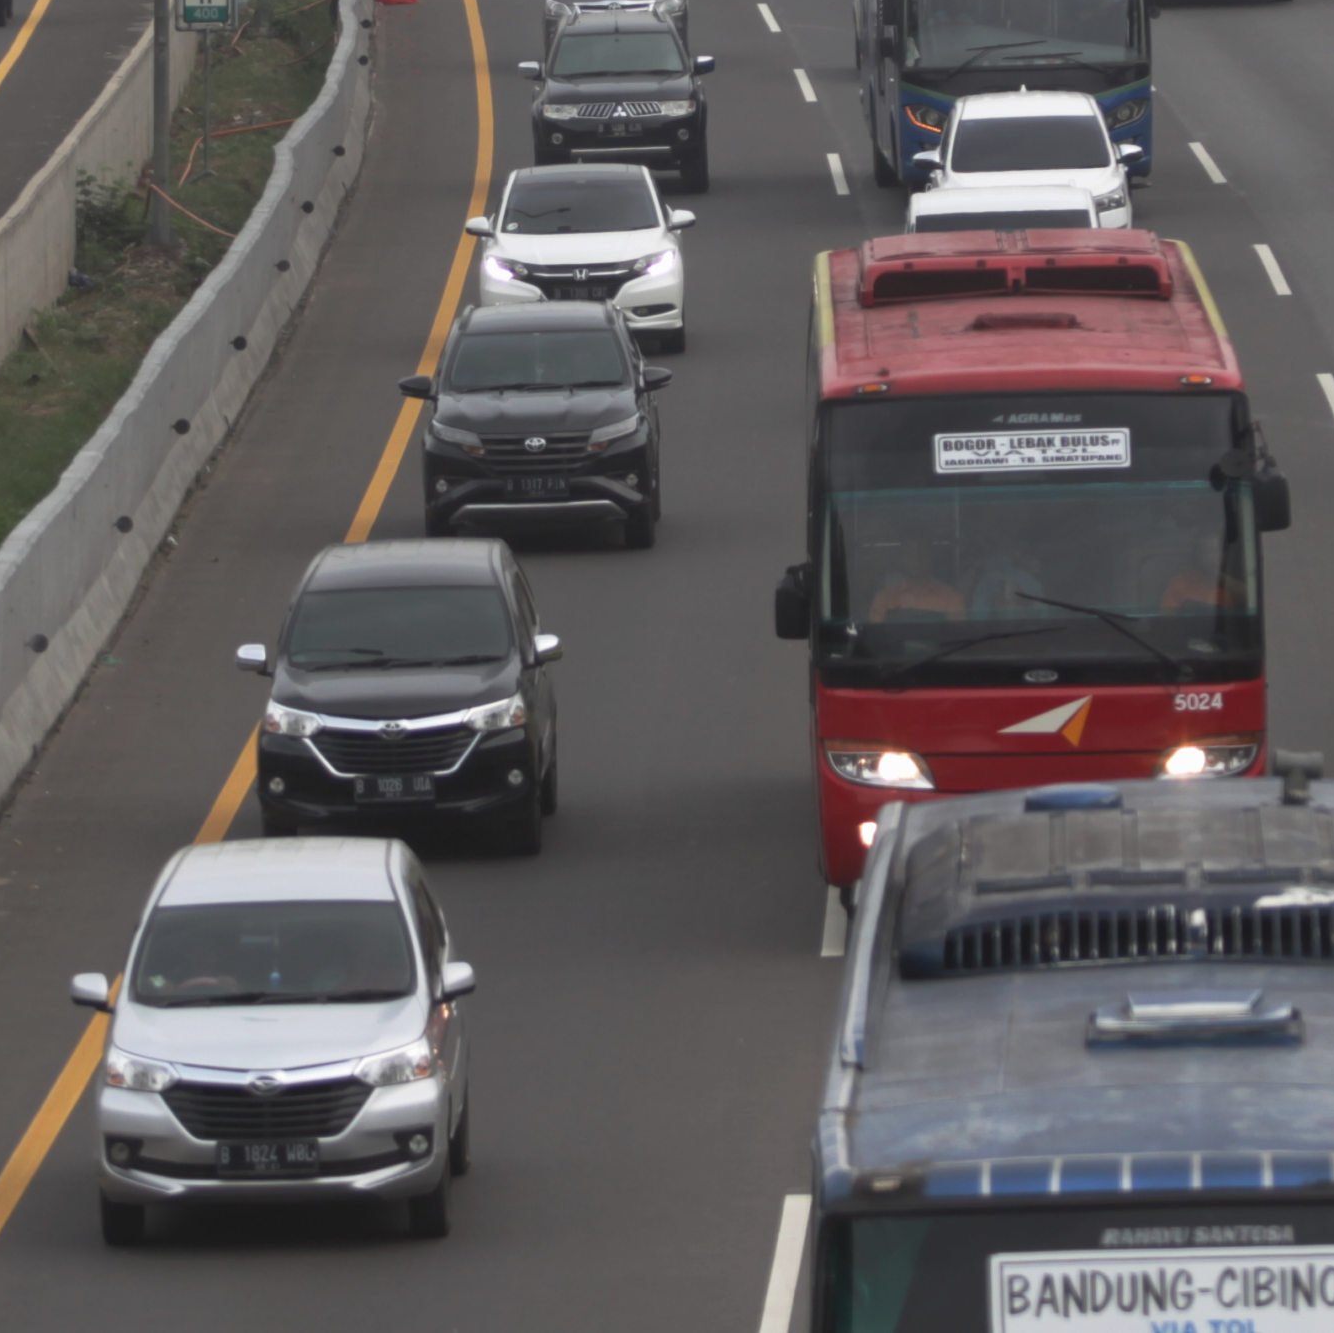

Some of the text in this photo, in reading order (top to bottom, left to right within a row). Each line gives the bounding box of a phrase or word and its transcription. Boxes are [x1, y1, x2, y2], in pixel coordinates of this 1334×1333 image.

[193, 8, 218, 19] 400
[943, 439, 996, 452] BOGOR
[1009, 436, 1056, 450] LEBAK
[1060, 434, 1110, 448] BULUS
[944, 457, 1008, 467] JAGORAWI
[1042, 453, 1123, 464] SIMATUPANG
[1174, 693, 1223, 711] 5024
[356, 777, 365, 794] B
[378, 777, 403, 793] 1026
[221, 1146, 230, 1165] B
[244, 1144, 278, 1163] 1824
[1191, 1225, 1295, 1244] SANTOSA
